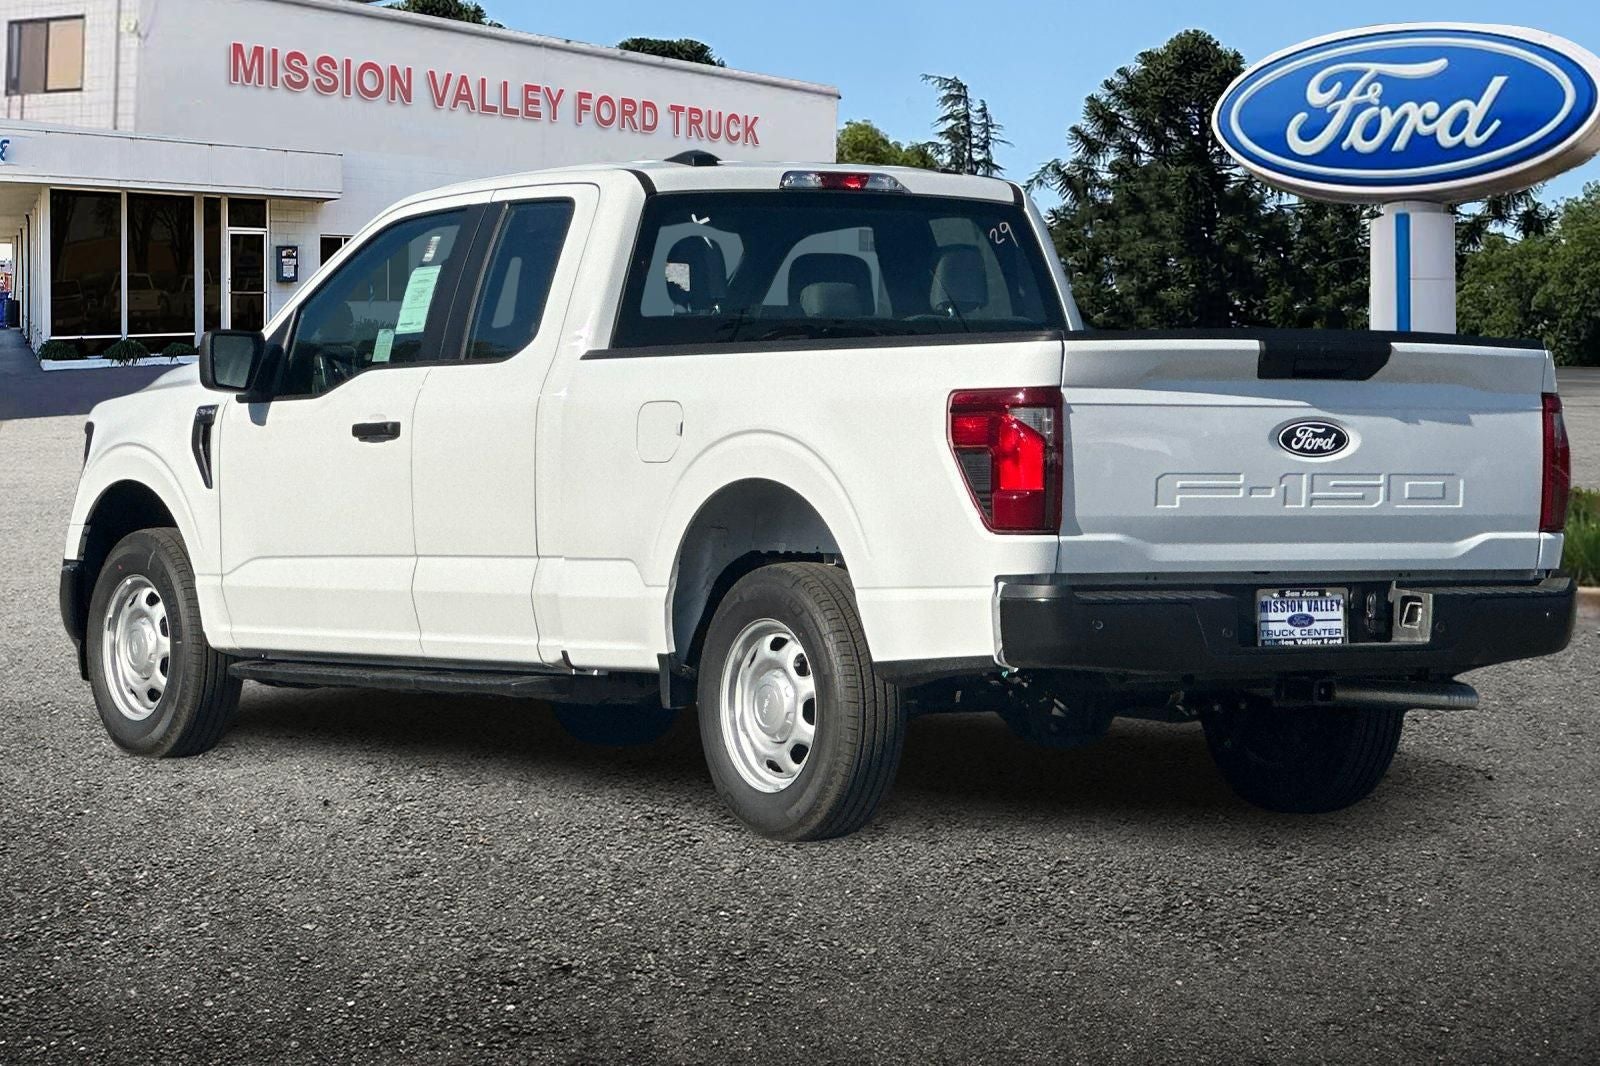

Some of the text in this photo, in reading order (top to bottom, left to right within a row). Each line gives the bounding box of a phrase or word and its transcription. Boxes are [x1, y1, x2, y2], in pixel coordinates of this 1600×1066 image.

[229, 40, 760, 146] MISSION VALLEY FORD TRUCK
[1286, 57, 1509, 157] Ford
[989, 222, 1019, 248] 29
[1291, 427, 1337, 451] Ford
[1154, 472, 1465, 508] F-150
[1260, 599, 1341, 614] MISSION VALLEY
[1261, 627, 1342, 638] TRUCK CENTER
